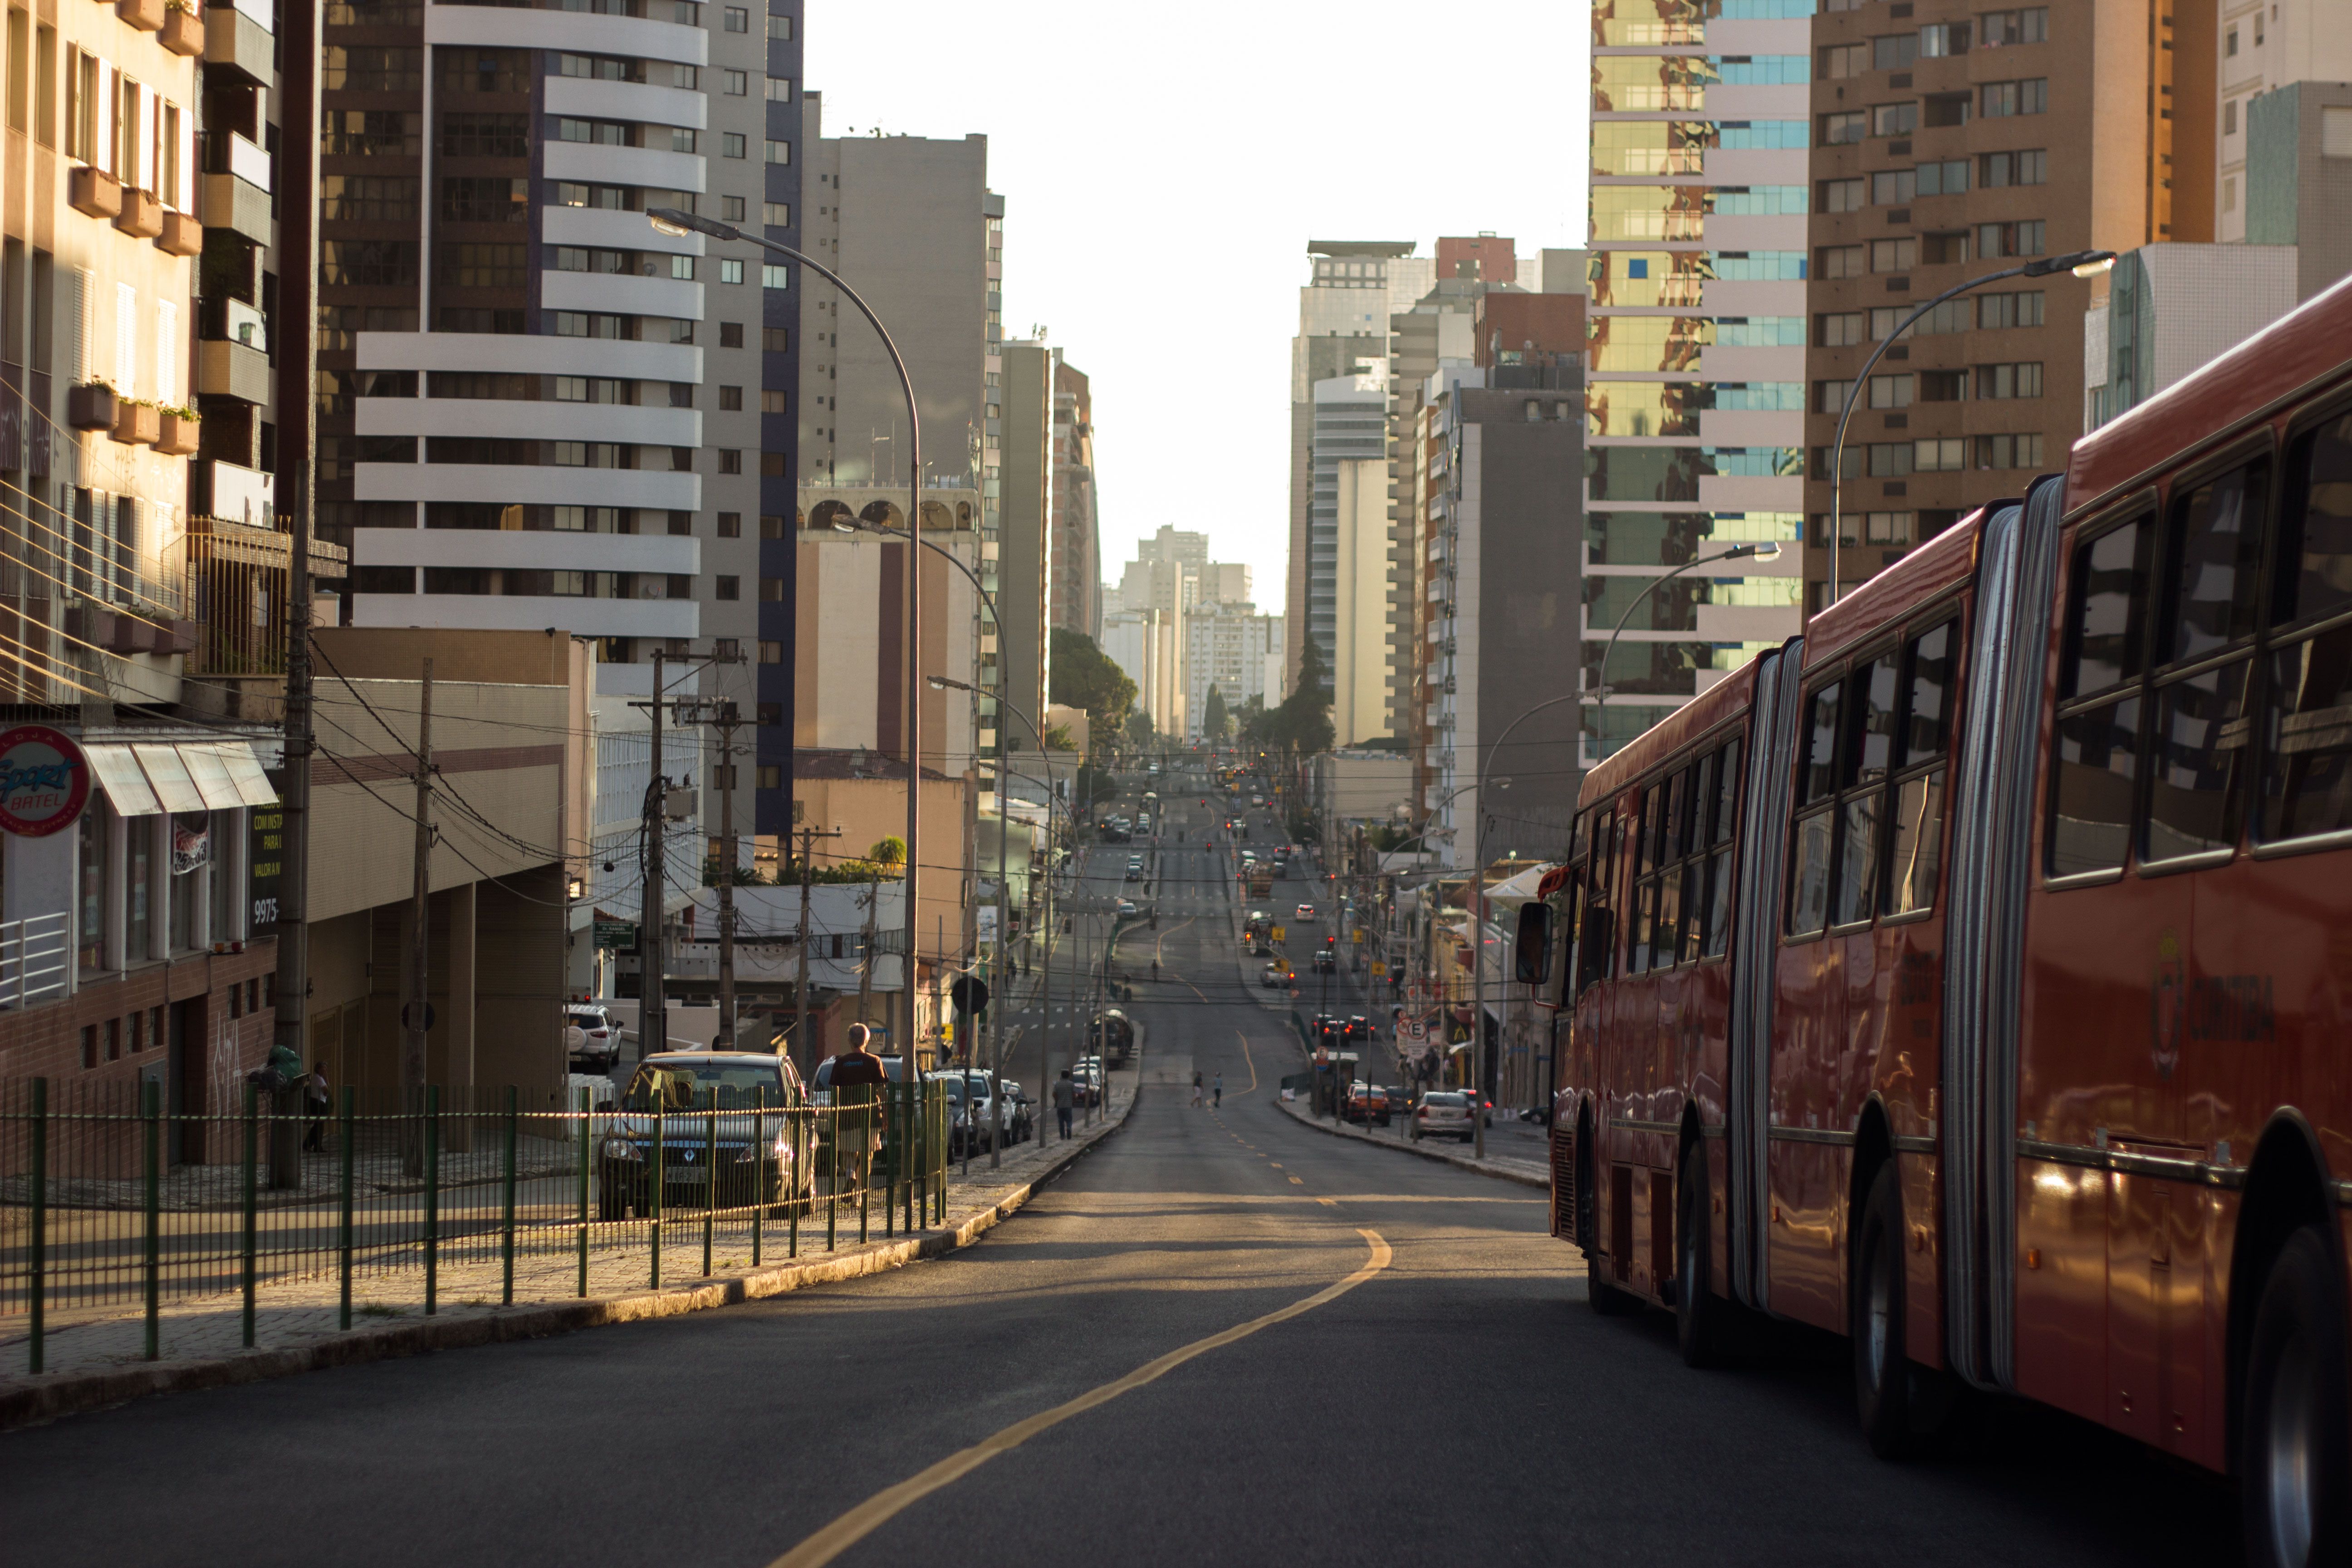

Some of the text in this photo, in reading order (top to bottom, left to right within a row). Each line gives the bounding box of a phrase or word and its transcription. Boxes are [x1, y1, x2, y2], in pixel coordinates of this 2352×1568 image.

[2, 732, 53, 747] LOJA
[11, 793, 61, 811] BATEL
[255, 815, 267, 830] COM
[264, 835, 278, 850] PARA
[255, 863, 271, 877] VALOR
[2191, 975, 2274, 1043] CURITIBA
[1412, 1023, 1421, 1036] E
